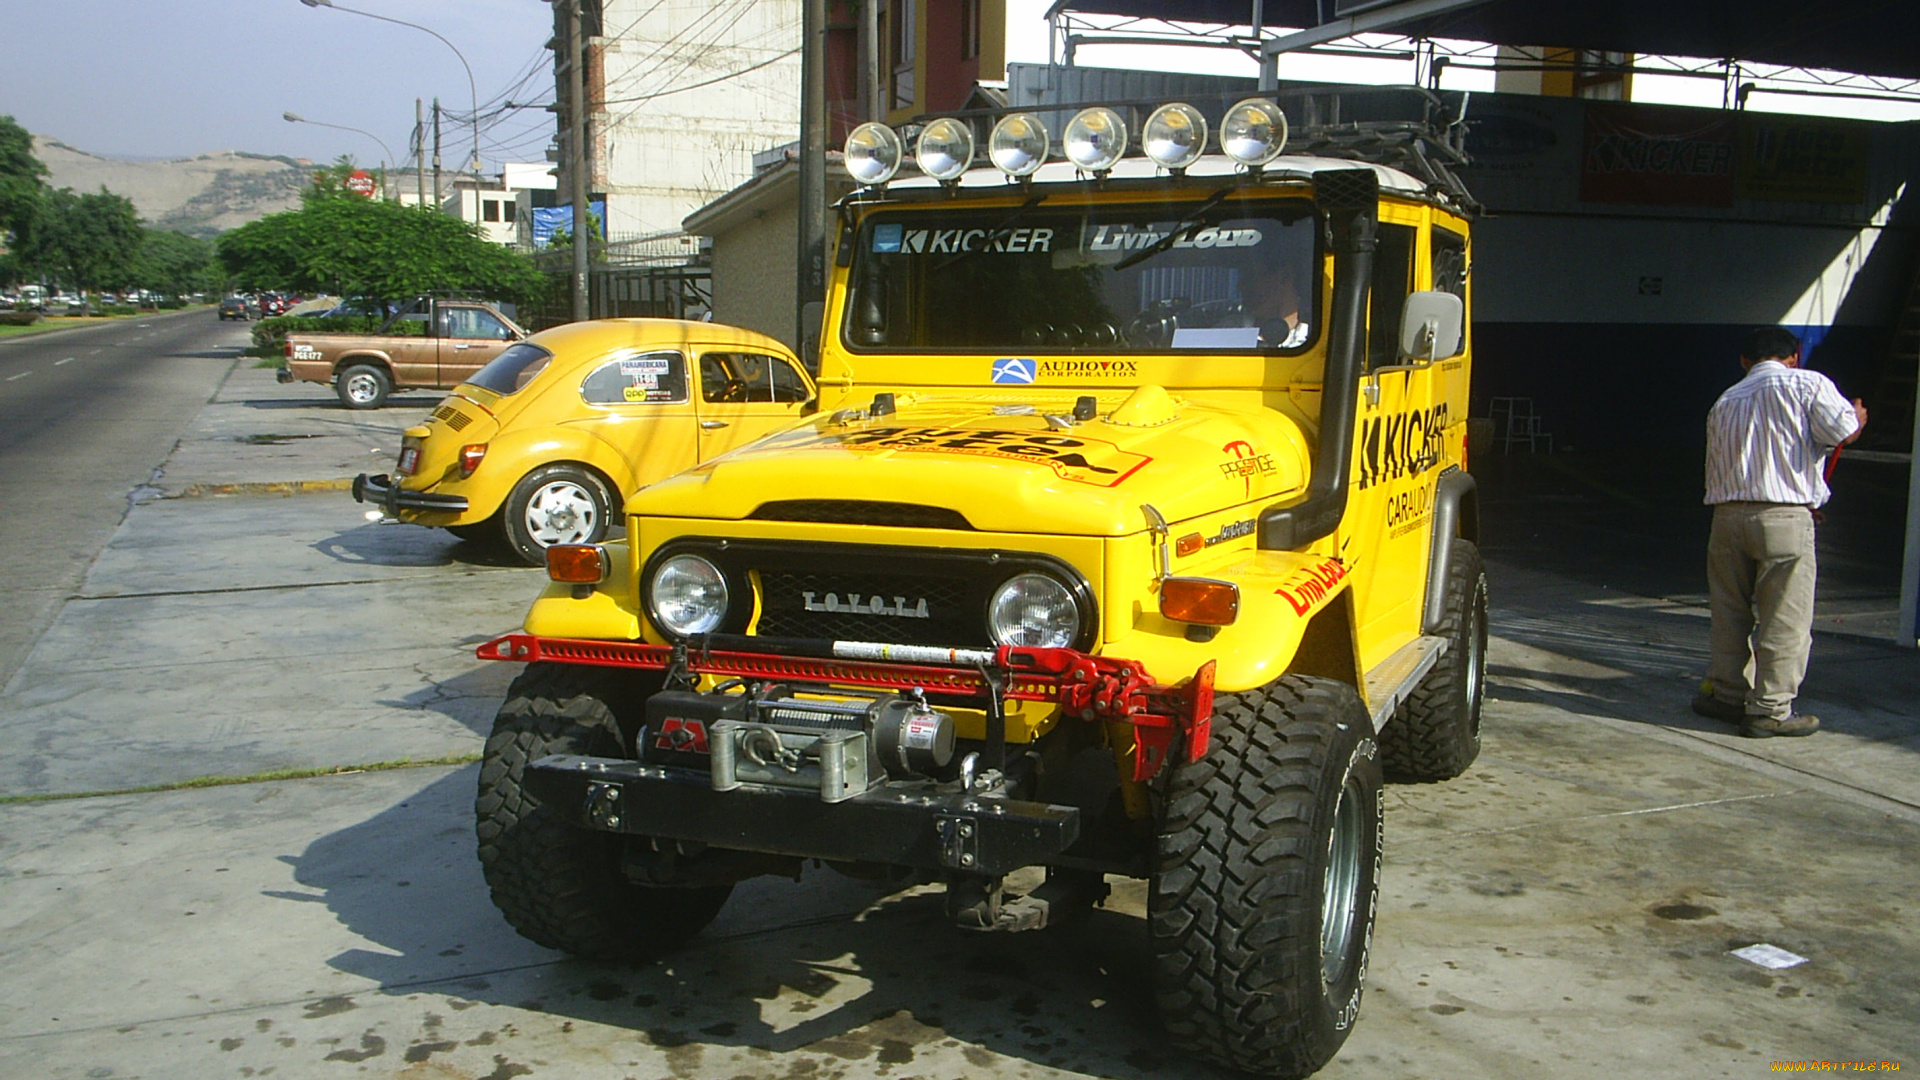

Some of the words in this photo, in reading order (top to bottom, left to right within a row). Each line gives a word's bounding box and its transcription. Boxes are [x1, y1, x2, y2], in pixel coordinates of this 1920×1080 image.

[1614, 137, 1733, 176] KICKER
[929, 228, 1053, 254] KICKER
[621, 360, 667, 369] PANAMERICANA
[1038, 361, 1138, 371] AUDIOVOX
[625, 390, 645, 398] RPP
[1381, 402, 1448, 483] KICKER
[1219, 453, 1277, 480] PRESTIGE
[801, 591, 930, 619] TOYOTA
